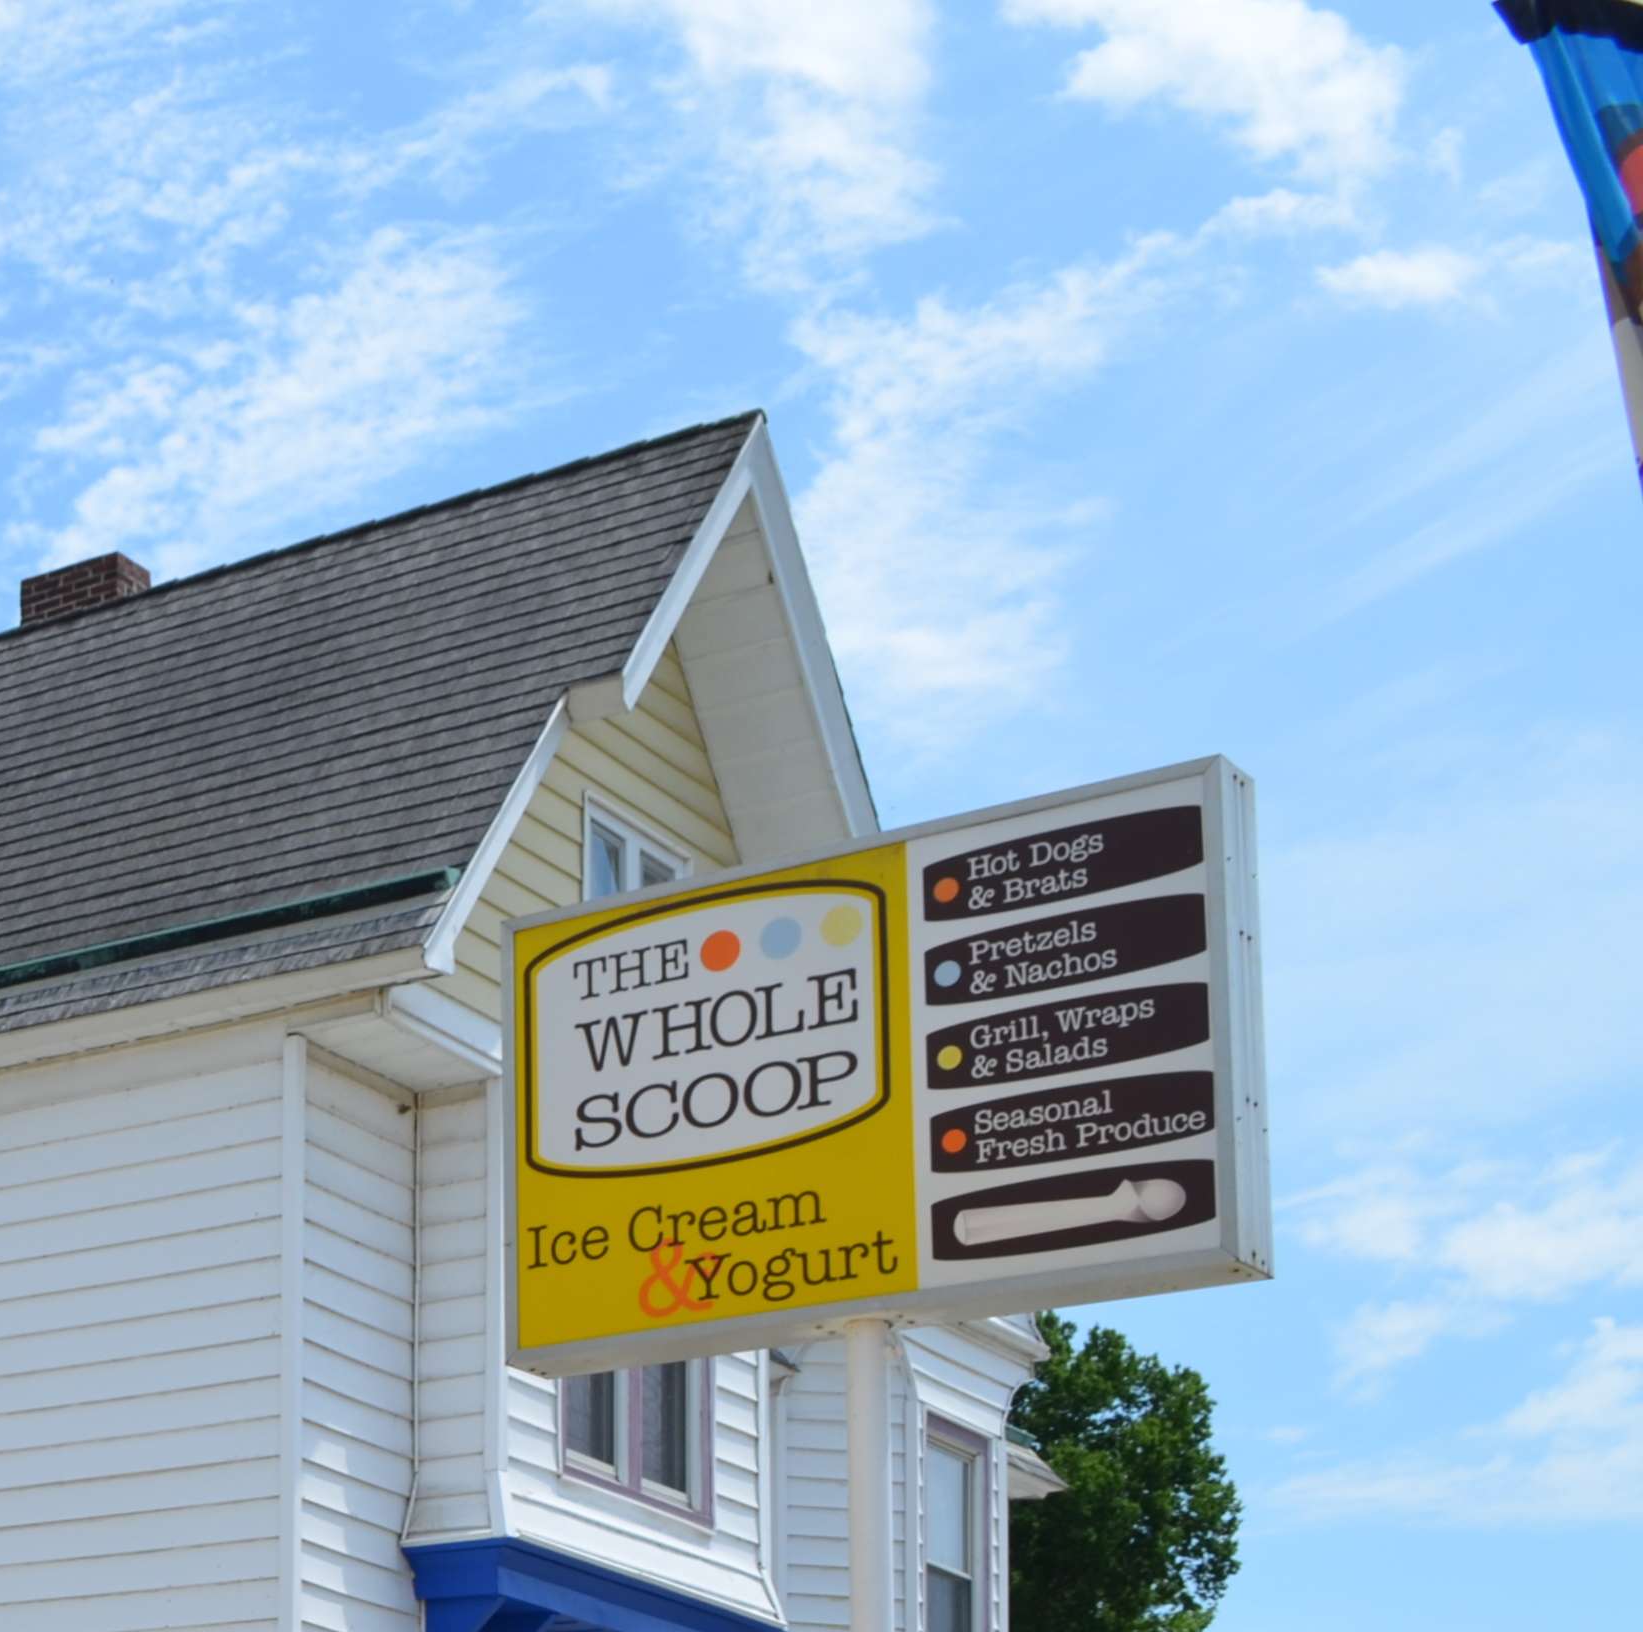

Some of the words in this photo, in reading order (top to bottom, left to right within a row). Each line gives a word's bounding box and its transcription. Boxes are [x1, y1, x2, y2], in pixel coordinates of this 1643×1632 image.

[967, 847, 1020, 881] Hot
[1029, 831, 1105, 869] Dogs
[967, 886, 995, 911] &
[1003, 866, 1090, 904] Brats
[572, 937, 690, 1000] THE
[968, 919, 1098, 966] Pretzels
[968, 969, 997, 995] &
[1005, 948, 1118, 989] Nachos
[575, 967, 860, 1073] WHOLE
[969, 1015, 1050, 1051] Grill,
[1055, 997, 1156, 1035] Wraps
[969, 1053, 999, 1080] &
[1005, 1036, 1110, 1075] Salads
[574, 1050, 860, 1152] SCOOP
[973, 1091, 1115, 1136] Seasonal
[976, 1126, 1068, 1164] Fresh
[1076, 1106, 1207, 1147] Produce
[526, 1221, 610, 1271] Ice
[627, 1186, 828, 1258] Cream
[637, 1236, 715, 1319] &
[685, 1228, 899, 1303] Yogurt
